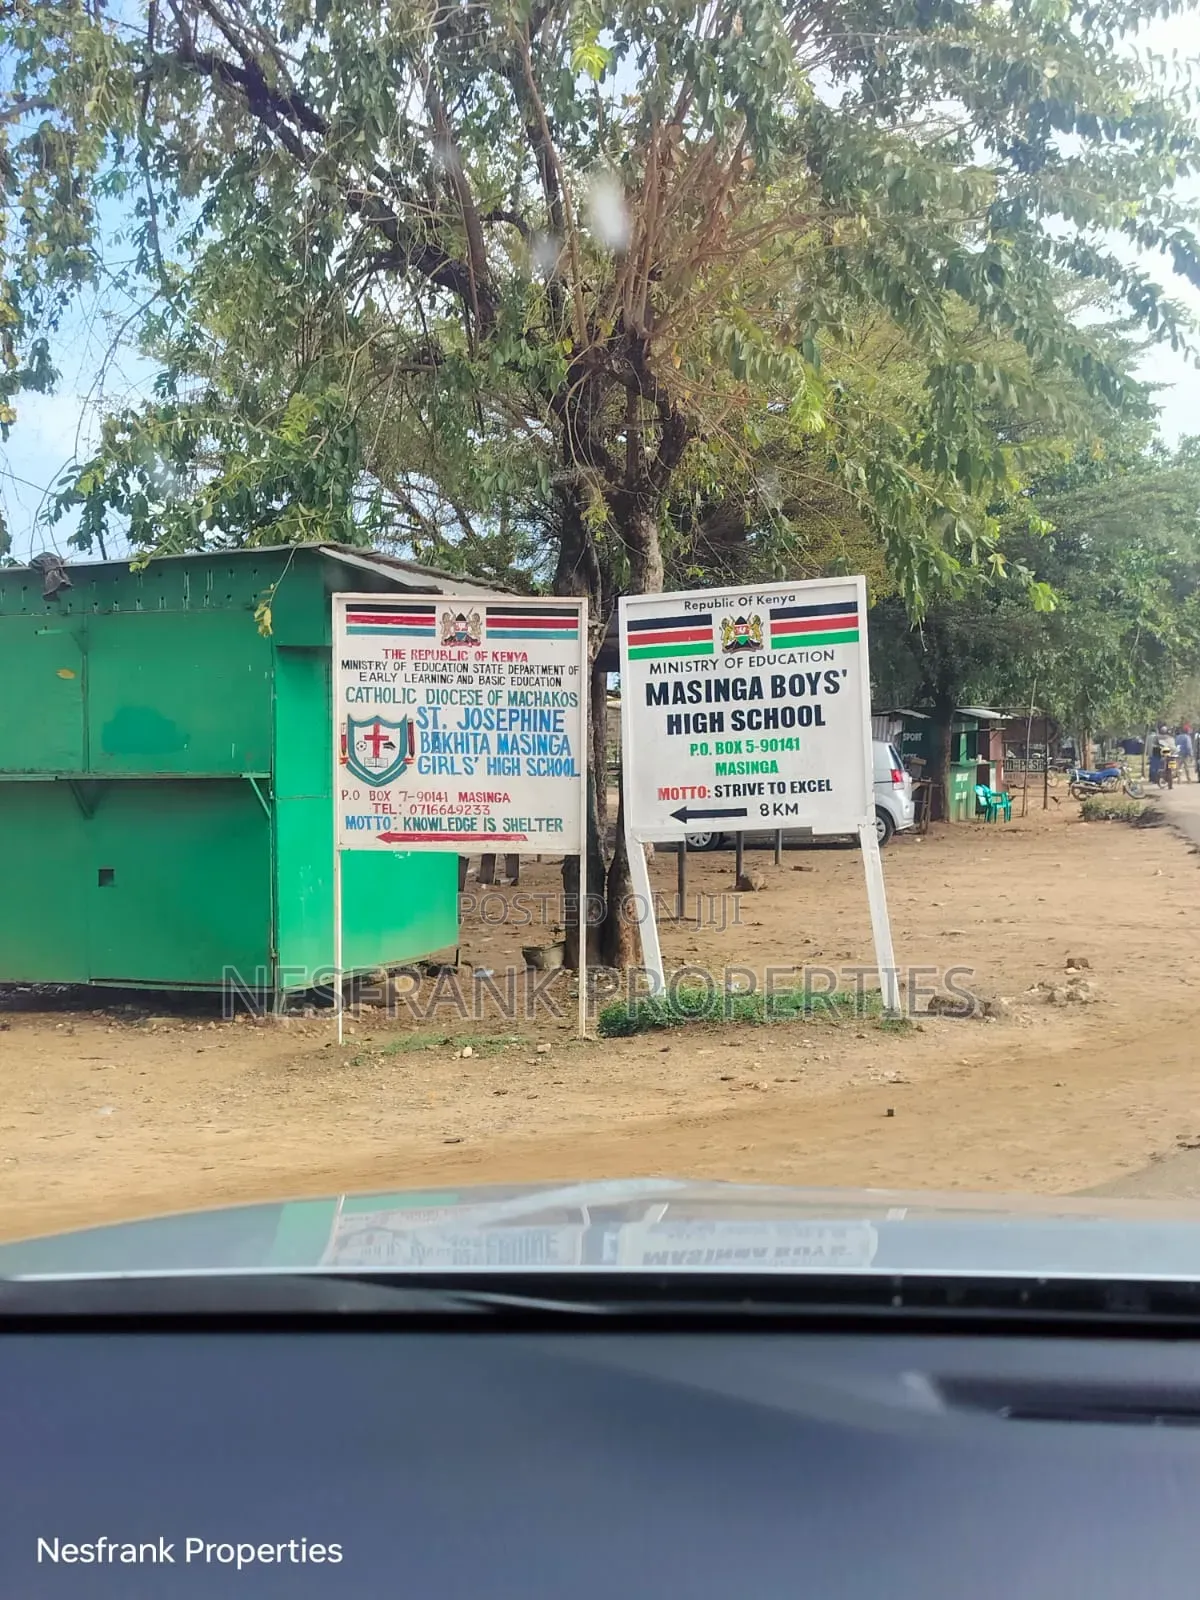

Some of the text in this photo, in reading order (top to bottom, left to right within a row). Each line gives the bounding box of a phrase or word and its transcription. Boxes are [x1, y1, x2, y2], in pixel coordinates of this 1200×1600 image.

[684, 594, 796, 610] Republic Of Kenya
[382, 649, 528, 662] THE REPUBLIC OF KENYA
[650, 650, 834, 674] MINISTRY OF EDUCATION
[341, 660, 579, 675] MINISTRY OF EDUCATION STATE DEPARTMENT OF
[359, 671, 561, 687] EARLY LEARNING AND BASIC EDUCATION
[646, 669, 848, 706] MASINGA BOYS'
[346, 686, 578, 708] CATHOLIC DIOCESE OF MACHAKOS
[416, 706, 565, 733] ST. JOSEPHINE
[667, 704, 826, 735] HIGH SCHOOL
[420, 731, 571, 756] BAKHITA MASINGA
[690, 737, 800, 756] P.O. BOX 5-90141
[418, 755, 581, 778] GIRLS' HIGH SCHOOL
[715, 760, 779, 776] MASINGA
[341, 791, 511, 803] P.O BOX 7-90141 MASINGA
[658, 779, 832, 801] MOTTO: STRIVE TO EXCEL
[373, 803, 490, 815] TEL: 0716649233
[404, 816, 477, 832] KNOWLEDGE
[484, 818, 496, 832] IS
[503, 818, 563, 832] SHELTER
